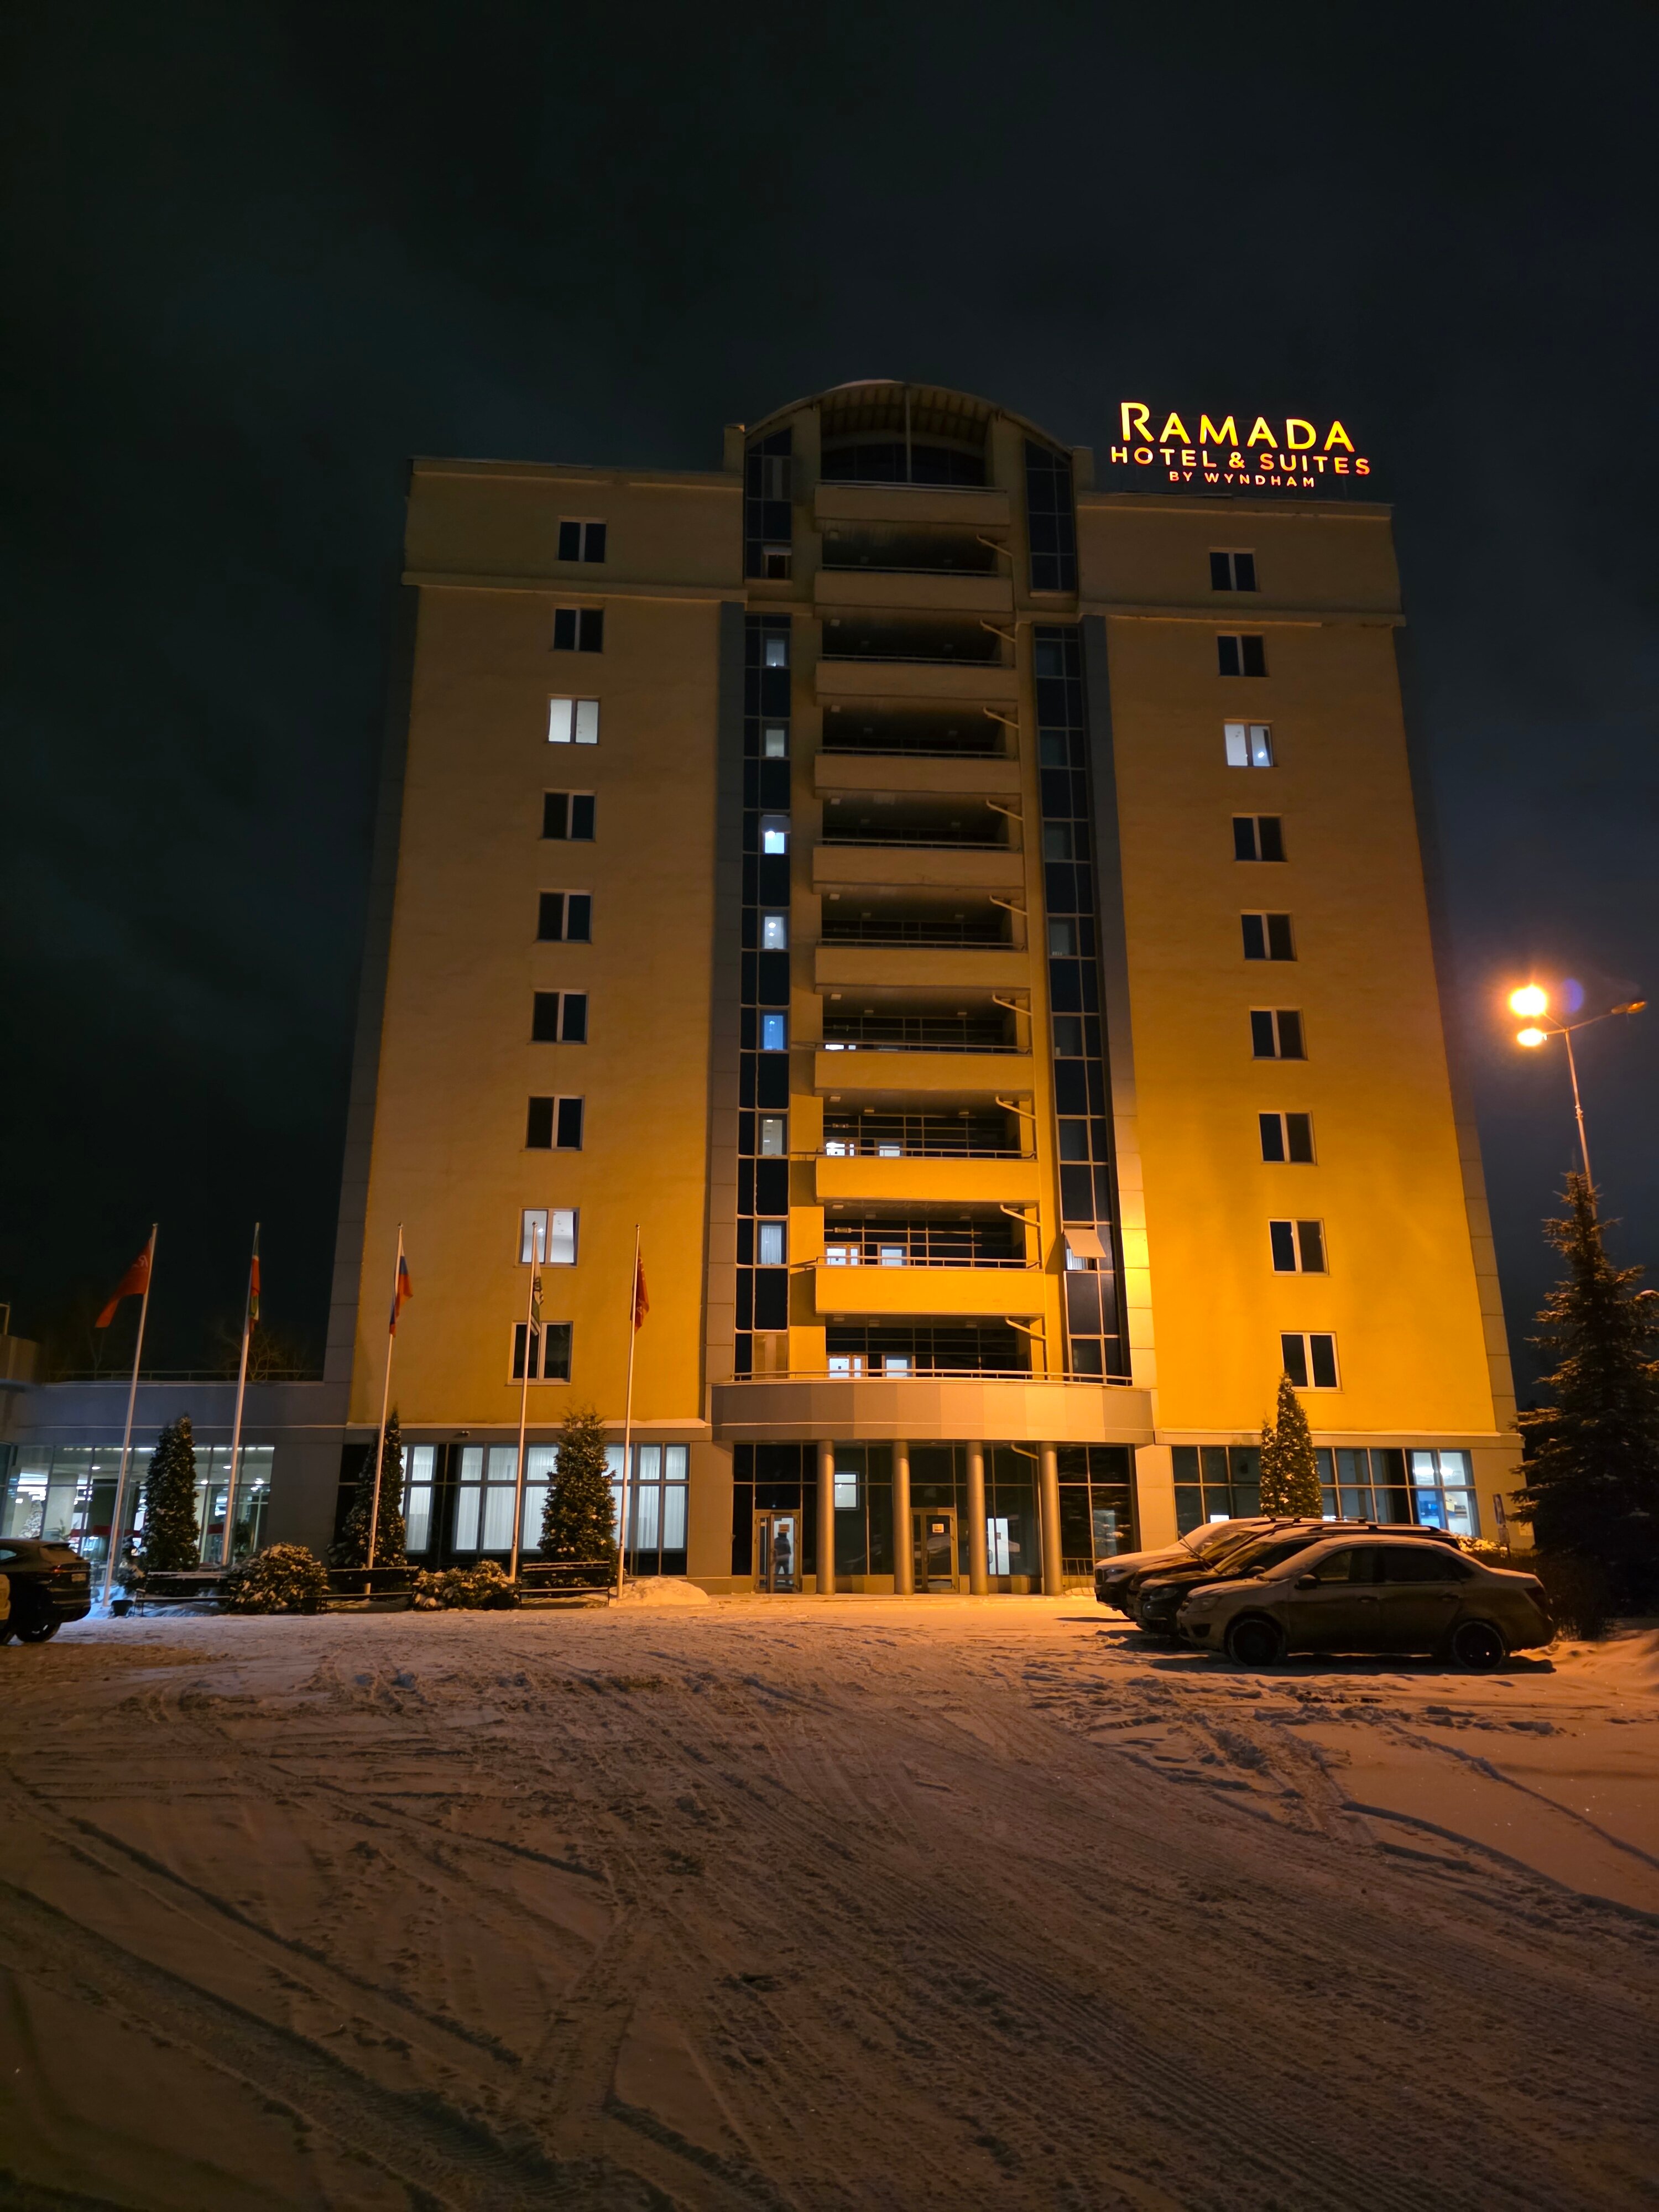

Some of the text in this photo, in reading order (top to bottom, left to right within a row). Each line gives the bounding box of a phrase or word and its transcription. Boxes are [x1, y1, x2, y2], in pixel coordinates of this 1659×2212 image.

[1120, 401, 1355, 453] RAMADA
[1110, 446, 1371, 476] HOTEL & SUITES
[1168, 470, 1315, 488] BY WYNDHAM
